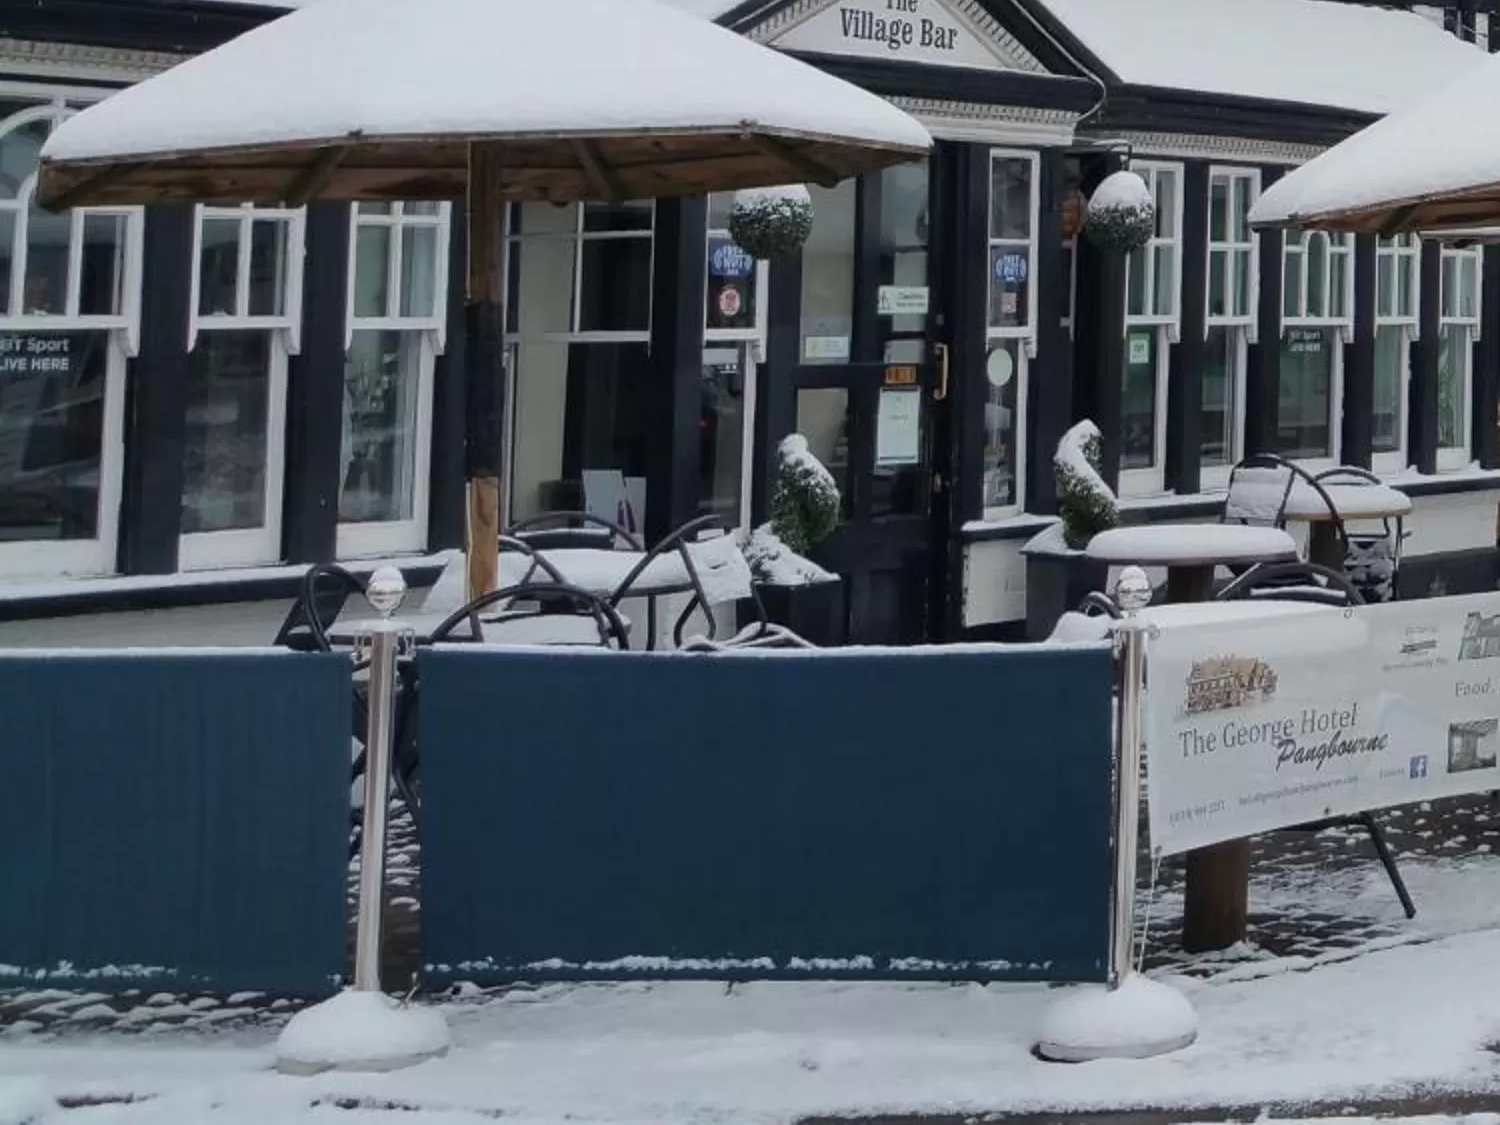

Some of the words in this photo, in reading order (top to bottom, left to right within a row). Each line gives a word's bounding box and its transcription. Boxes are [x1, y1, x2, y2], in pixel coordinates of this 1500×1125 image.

[840, 8, 913, 50] Village
[920, 18, 958, 50] Bar
[27, 337, 70, 354] Sport
[32, 358, 69, 372] HERE
[1179, 728, 1217, 758] The
[1222, 716, 1295, 749] George
[1300, 703, 1358, 736] Hotel
[1275, 730, 1389, 772] Pangbourne
